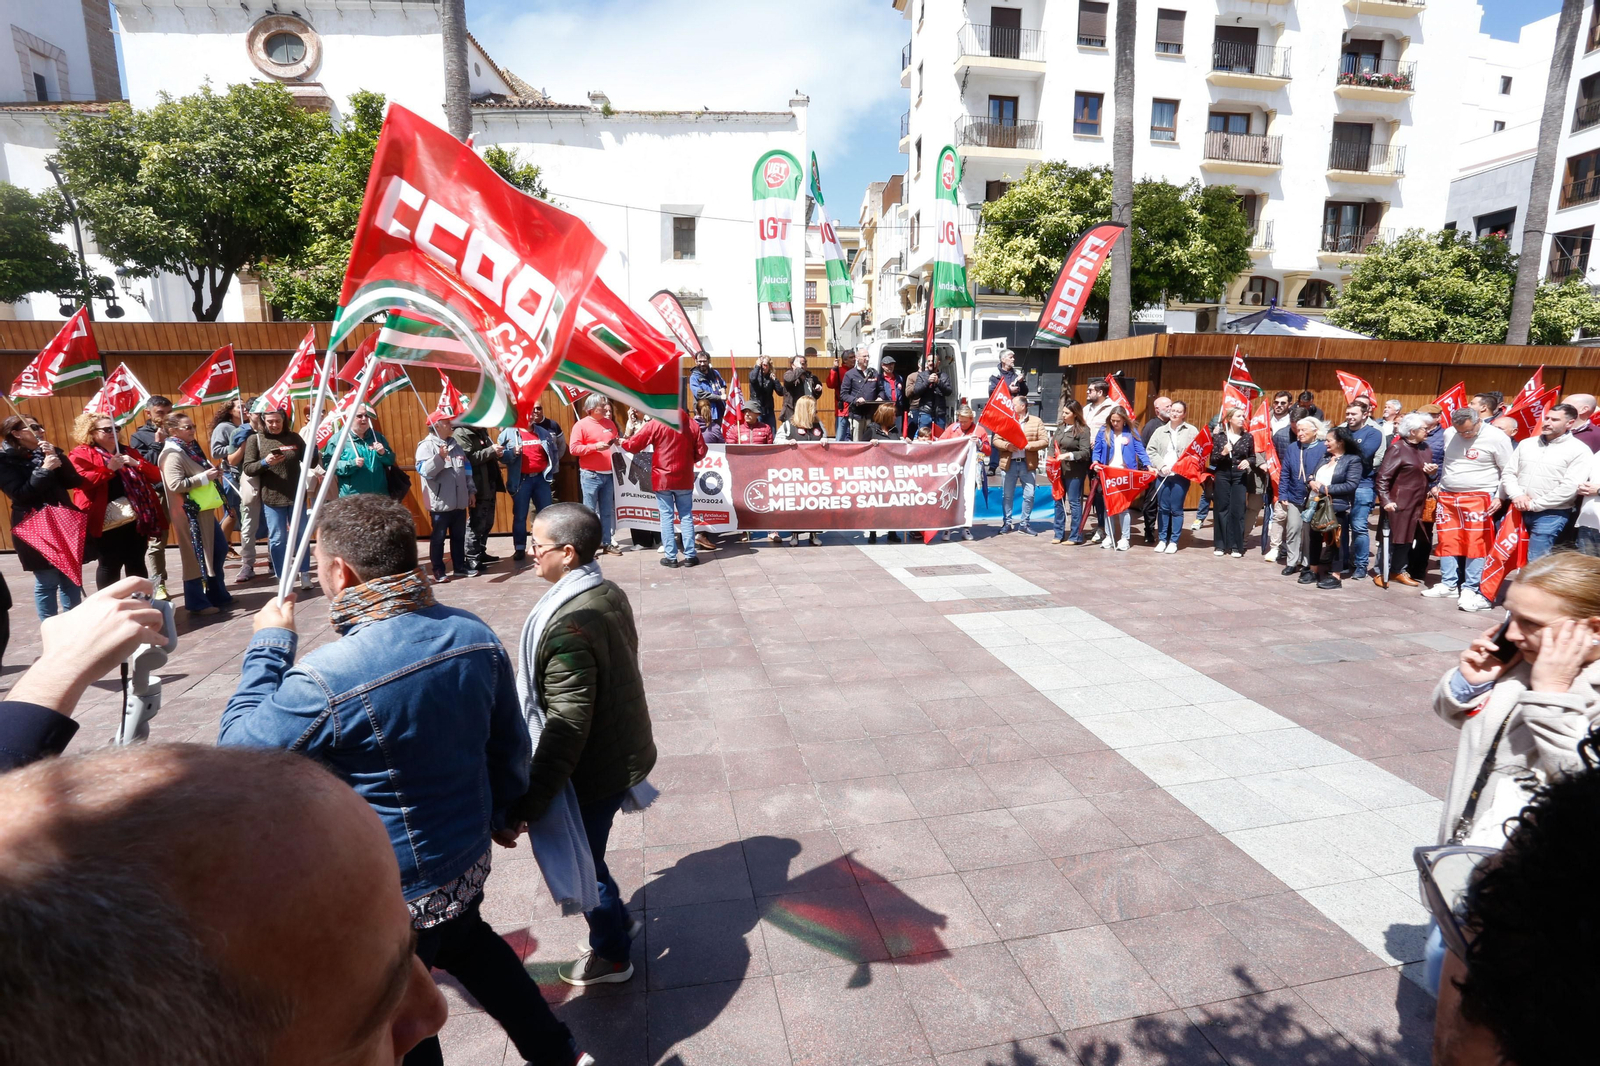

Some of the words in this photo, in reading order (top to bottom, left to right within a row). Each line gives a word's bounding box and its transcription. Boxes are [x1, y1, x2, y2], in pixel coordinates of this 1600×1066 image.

[768, 162, 788, 175] UGT
[938, 221, 956, 245] UG
[375, 175, 556, 341] CCOO
[1050, 235, 1107, 326] CCOO
[1047, 322, 1067, 335] Cádiz
[487, 322, 540, 389] Cád
[1191, 441, 1204, 456] SOE
[694, 457, 723, 469] 024
[767, 467, 805, 481] POR
[808, 467, 830, 480] EL
[833, 466, 889, 480] PLENO
[893, 462, 964, 478] EMPLEO:
[768, 481, 833, 497] MENOS
[836, 479, 922, 494] JORNADA,
[1105, 476, 1129, 488] PSOE
[621, 492, 657, 500] #PLENOEM
[768, 495, 852, 512] MEJORES
[856, 492, 937, 508] SALARIOS
[617, 508, 652, 518] CCOO
